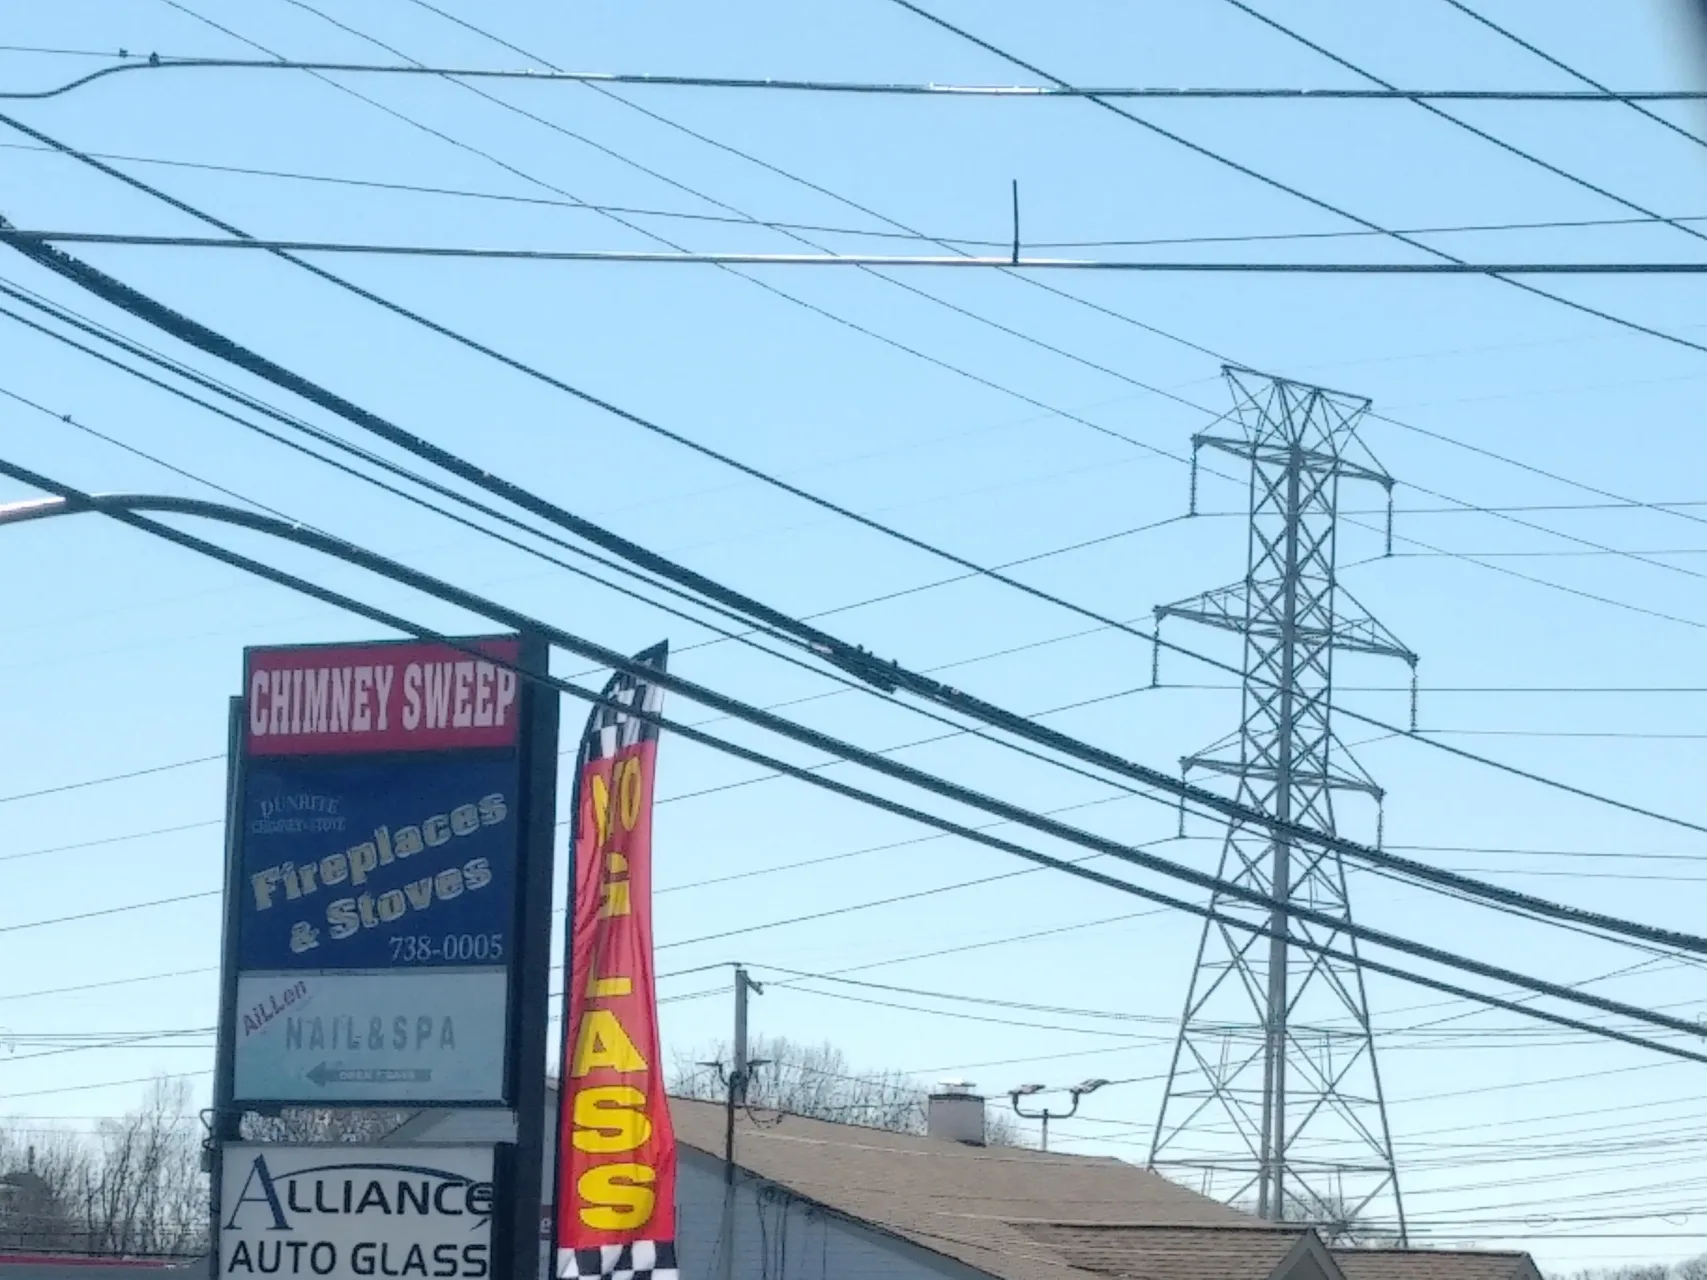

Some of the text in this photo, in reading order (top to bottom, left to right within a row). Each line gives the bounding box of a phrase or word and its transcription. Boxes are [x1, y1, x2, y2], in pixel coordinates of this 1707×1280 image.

[249, 660, 516, 736] CHIMNEY SWEEP
[250, 792, 508, 911] Fireplaces
[289, 856, 493, 953] & Stoves
[389, 933, 504, 962] 738-0005
[228, 1240, 487, 1279] AUTO GLASS
